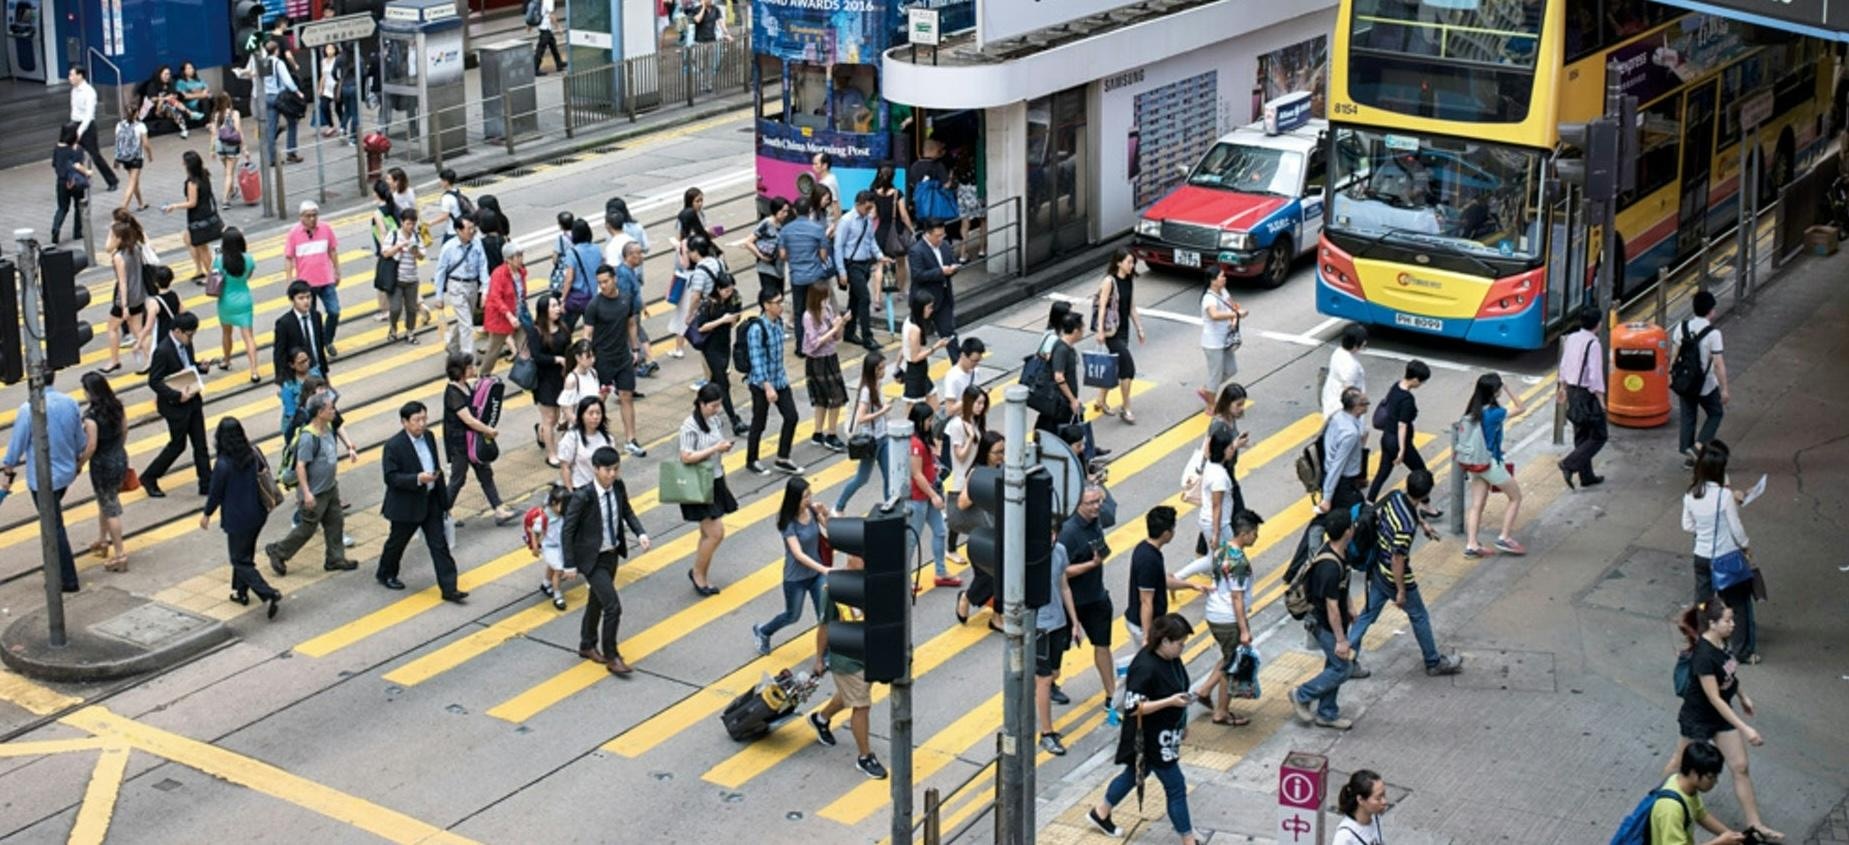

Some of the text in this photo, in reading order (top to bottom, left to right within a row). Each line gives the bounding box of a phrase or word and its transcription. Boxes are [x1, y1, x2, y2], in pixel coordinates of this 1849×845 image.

[789, 0, 840, 11] AWARDS
[843, 0, 874, 12] 2016
[1104, 69, 1145, 92] SAMSUNG
[1334, 102, 1358, 114] 8154
[762, 135, 870, 157] South China Morning Post
[1282, 813, 1311, 842] 中
